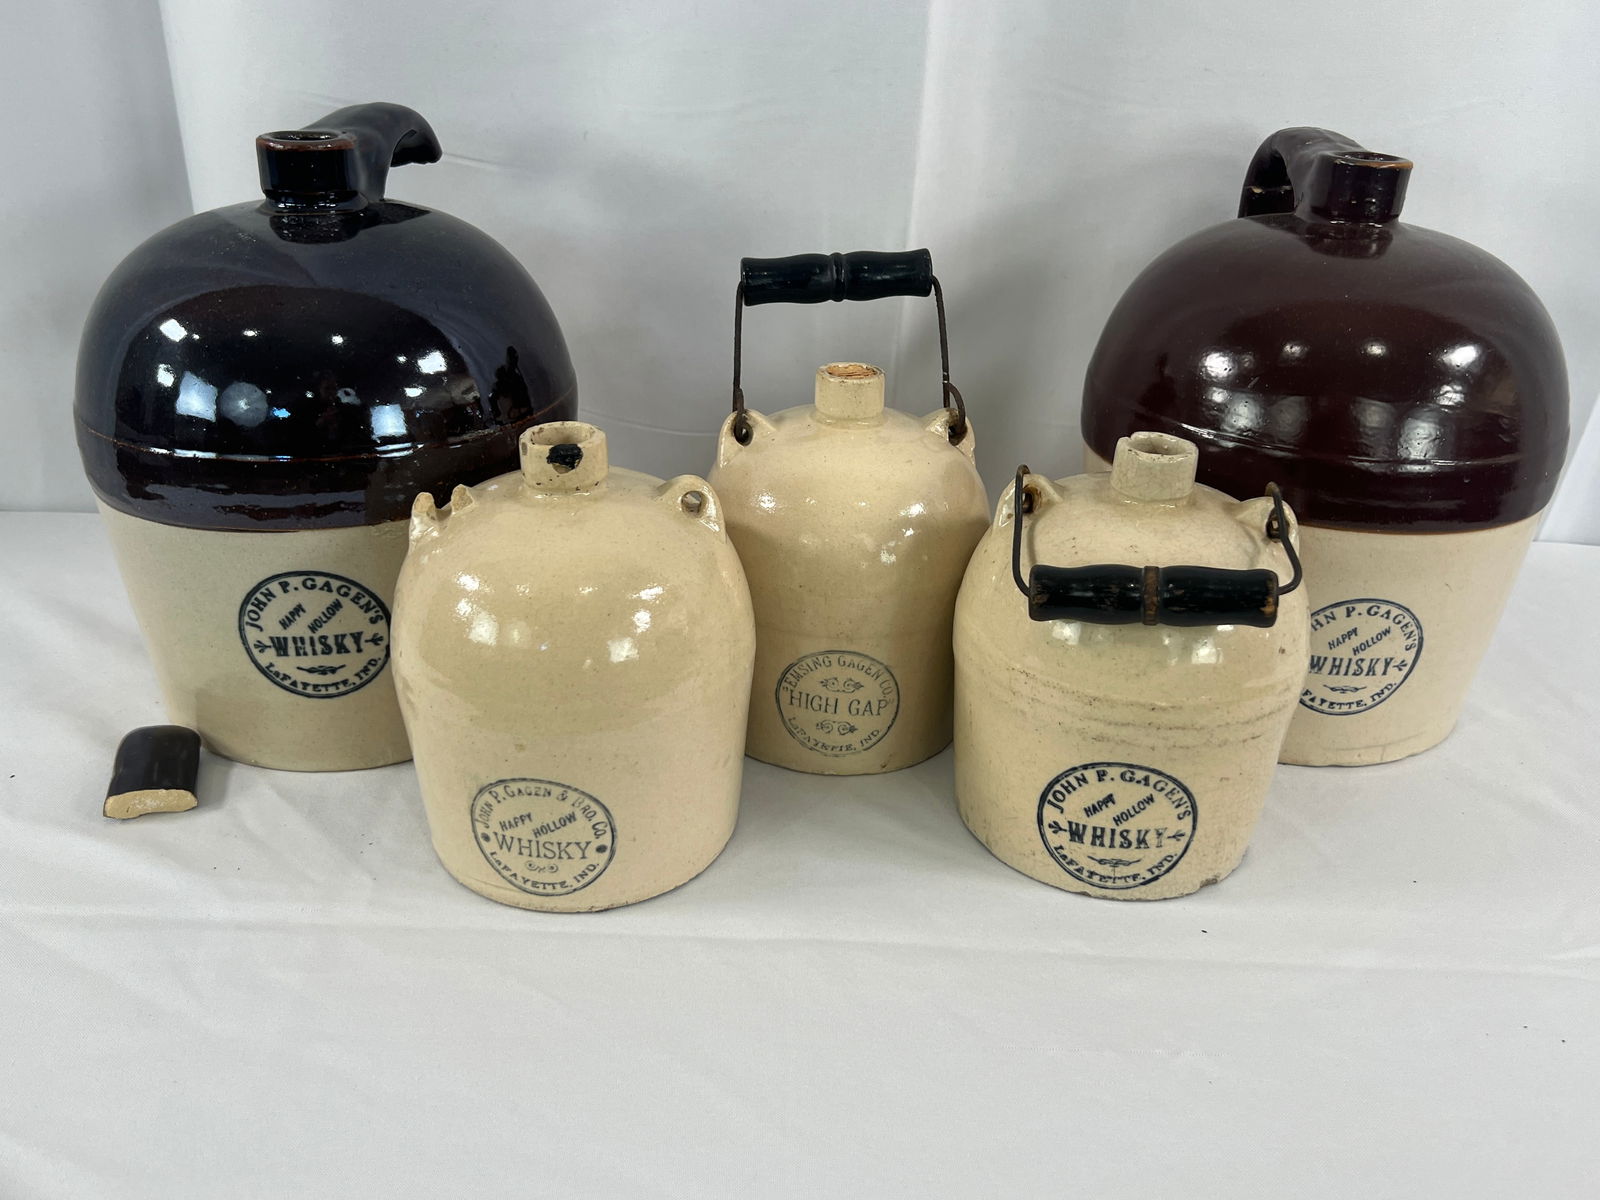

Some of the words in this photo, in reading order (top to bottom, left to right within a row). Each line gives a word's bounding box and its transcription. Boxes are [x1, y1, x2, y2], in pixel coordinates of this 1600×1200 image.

[246, 588, 276, 632] JOHN
[278, 603, 306, 630] HAPPY
[308, 598, 343, 634] HOLLOW
[269, 632, 364, 657] WHISKY
[1328, 627, 1358, 650] HAPPY
[1352, 626, 1391, 656] HOLLOW
[354, 657, 381, 680] IND.
[1309, 655, 1394, 676] WHISKY
[788, 690, 838, 714] HIGH
[848, 698, 888, 716] GAP
[556, 790, 568, 802] &
[1046, 773, 1088, 814] JOHN
[1084, 793, 1116, 818] HAPPY
[500, 812, 533, 832] HAPPY
[1113, 794, 1156, 826] HOLLOW
[532, 812, 577, 838] HOLLOW
[1068, 821, 1168, 848] WHISKY
[493, 831, 592, 860] WHISKY
